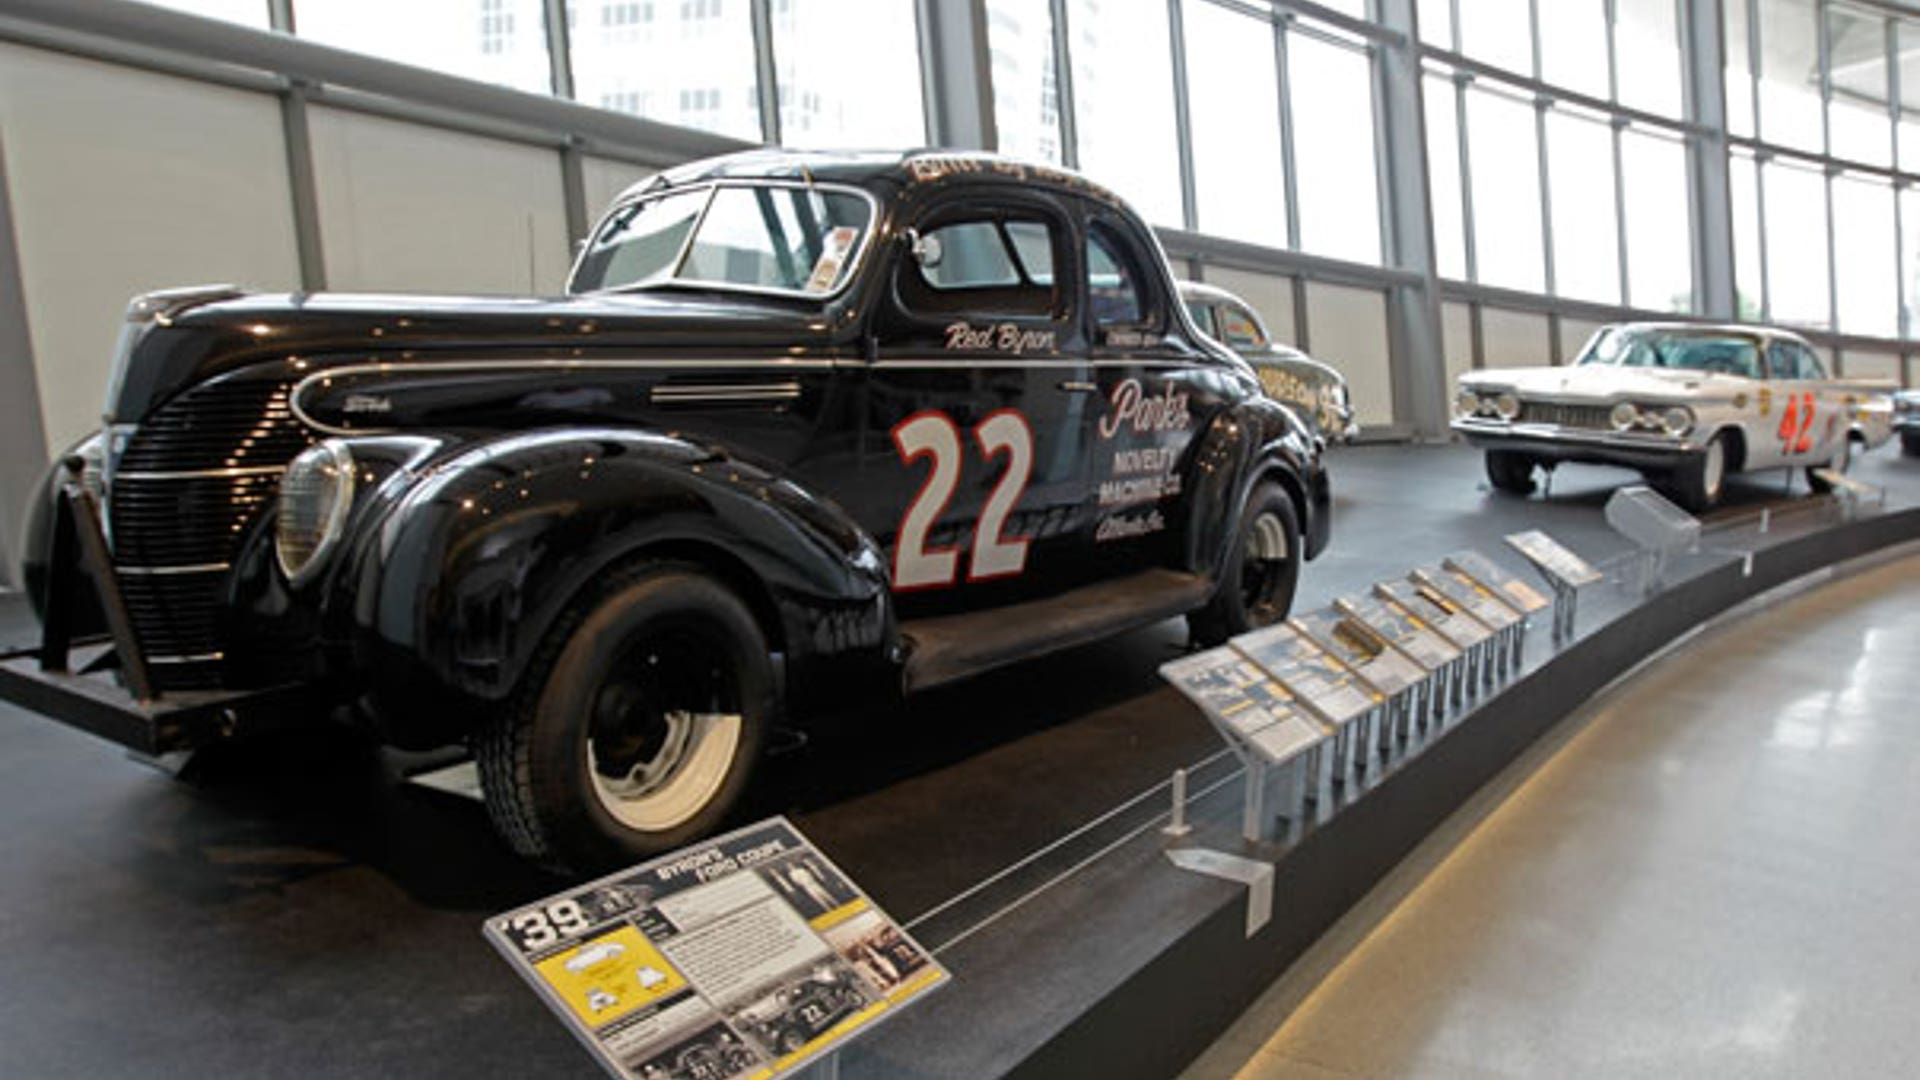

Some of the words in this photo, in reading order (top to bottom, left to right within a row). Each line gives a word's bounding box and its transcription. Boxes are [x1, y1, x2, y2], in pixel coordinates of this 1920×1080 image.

[945, 321, 995, 350] Red
[1099, 378, 1190, 439] Parks
[1778, 391, 1816, 456] 42
[890, 408, 1034, 590] 22
[500, 898, 590, 951] '39
